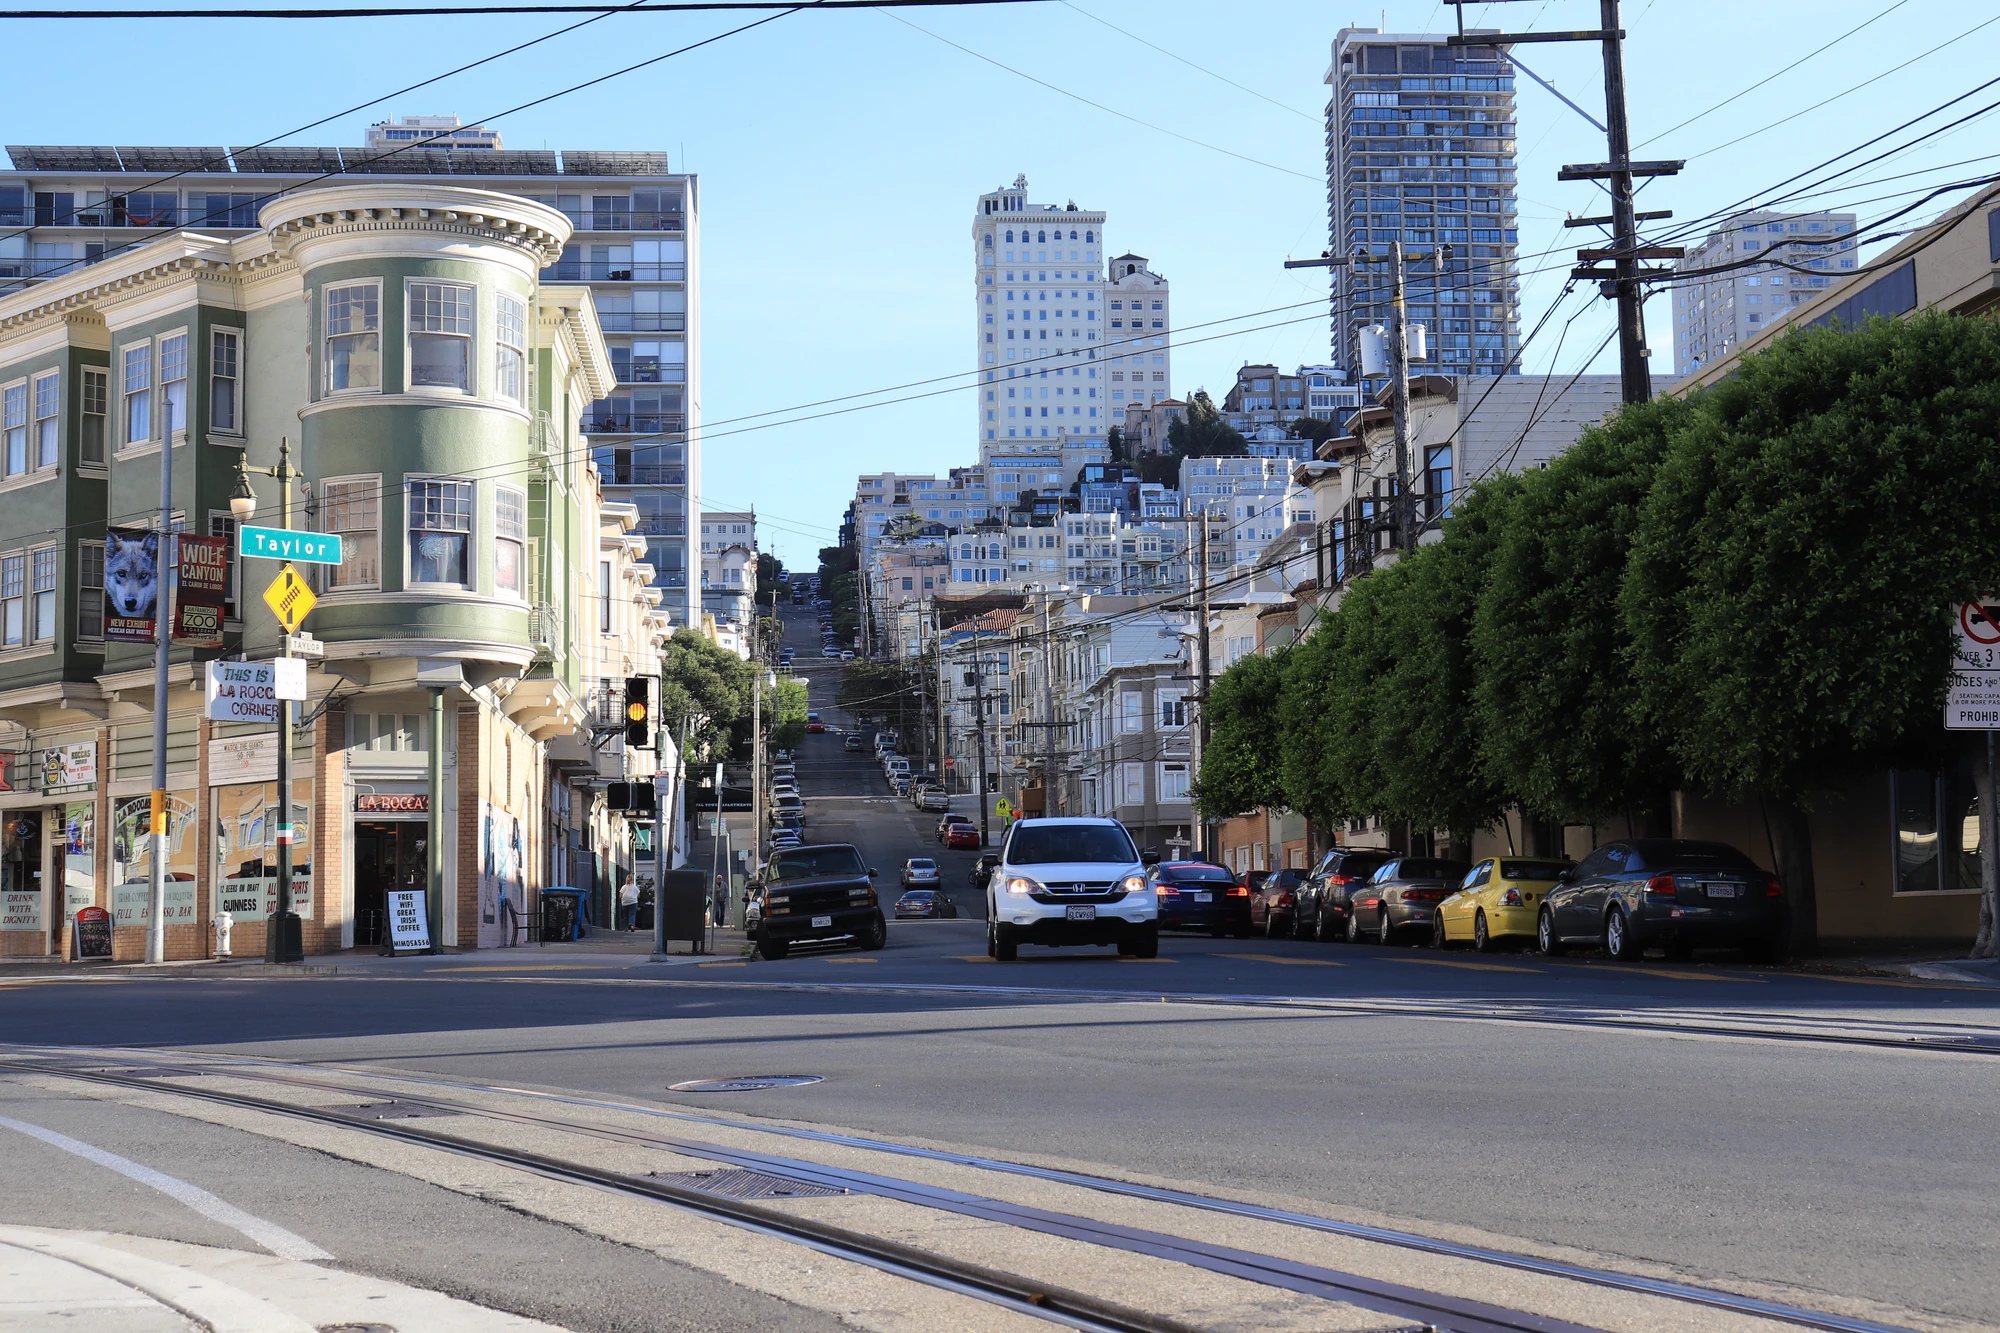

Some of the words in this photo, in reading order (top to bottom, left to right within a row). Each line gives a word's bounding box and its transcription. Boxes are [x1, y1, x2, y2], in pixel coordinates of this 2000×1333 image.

[255, 534, 326, 556] Taylor
[182, 543, 225, 566] WOLF
[182, 564, 223, 582] CANYON
[194, 606, 216, 614] FRANCISCO
[110, 618, 125, 627] NEW
[126, 619, 149, 629] EXHIBIT
[184, 614, 216, 628] ZOO
[293, 640, 320, 651] TAYLOR
[1958, 651, 1980, 660] OVER
[1985, 648, 1993, 662] 3
[224, 667, 251, 682] THIS
[255, 669, 269, 683] IS
[1948, 676, 1982, 687] BUSES
[219, 683, 236, 698] LA
[239, 685, 275, 700] ROCC
[231, 701, 279, 717] CORNER
[249, 740, 264, 749] GIANTS
[360, 796, 377, 808] LA
[225, 884, 238, 893] BEERS
[239, 884, 245, 893] ON
[247, 883, 260, 892] DRAFT
[266, 882, 276, 896] ALL
[292, 881, 309, 894] PORTS
[7, 894, 34, 902] DRINK
[9, 905, 31, 913] WITH
[223, 898, 257, 912] GUINNESS
[116, 908, 132, 919] FULL
[178, 906, 192, 917] BAR
[3, 915, 38, 924] DIGNITY
[397, 924, 420, 932] COFFEE
